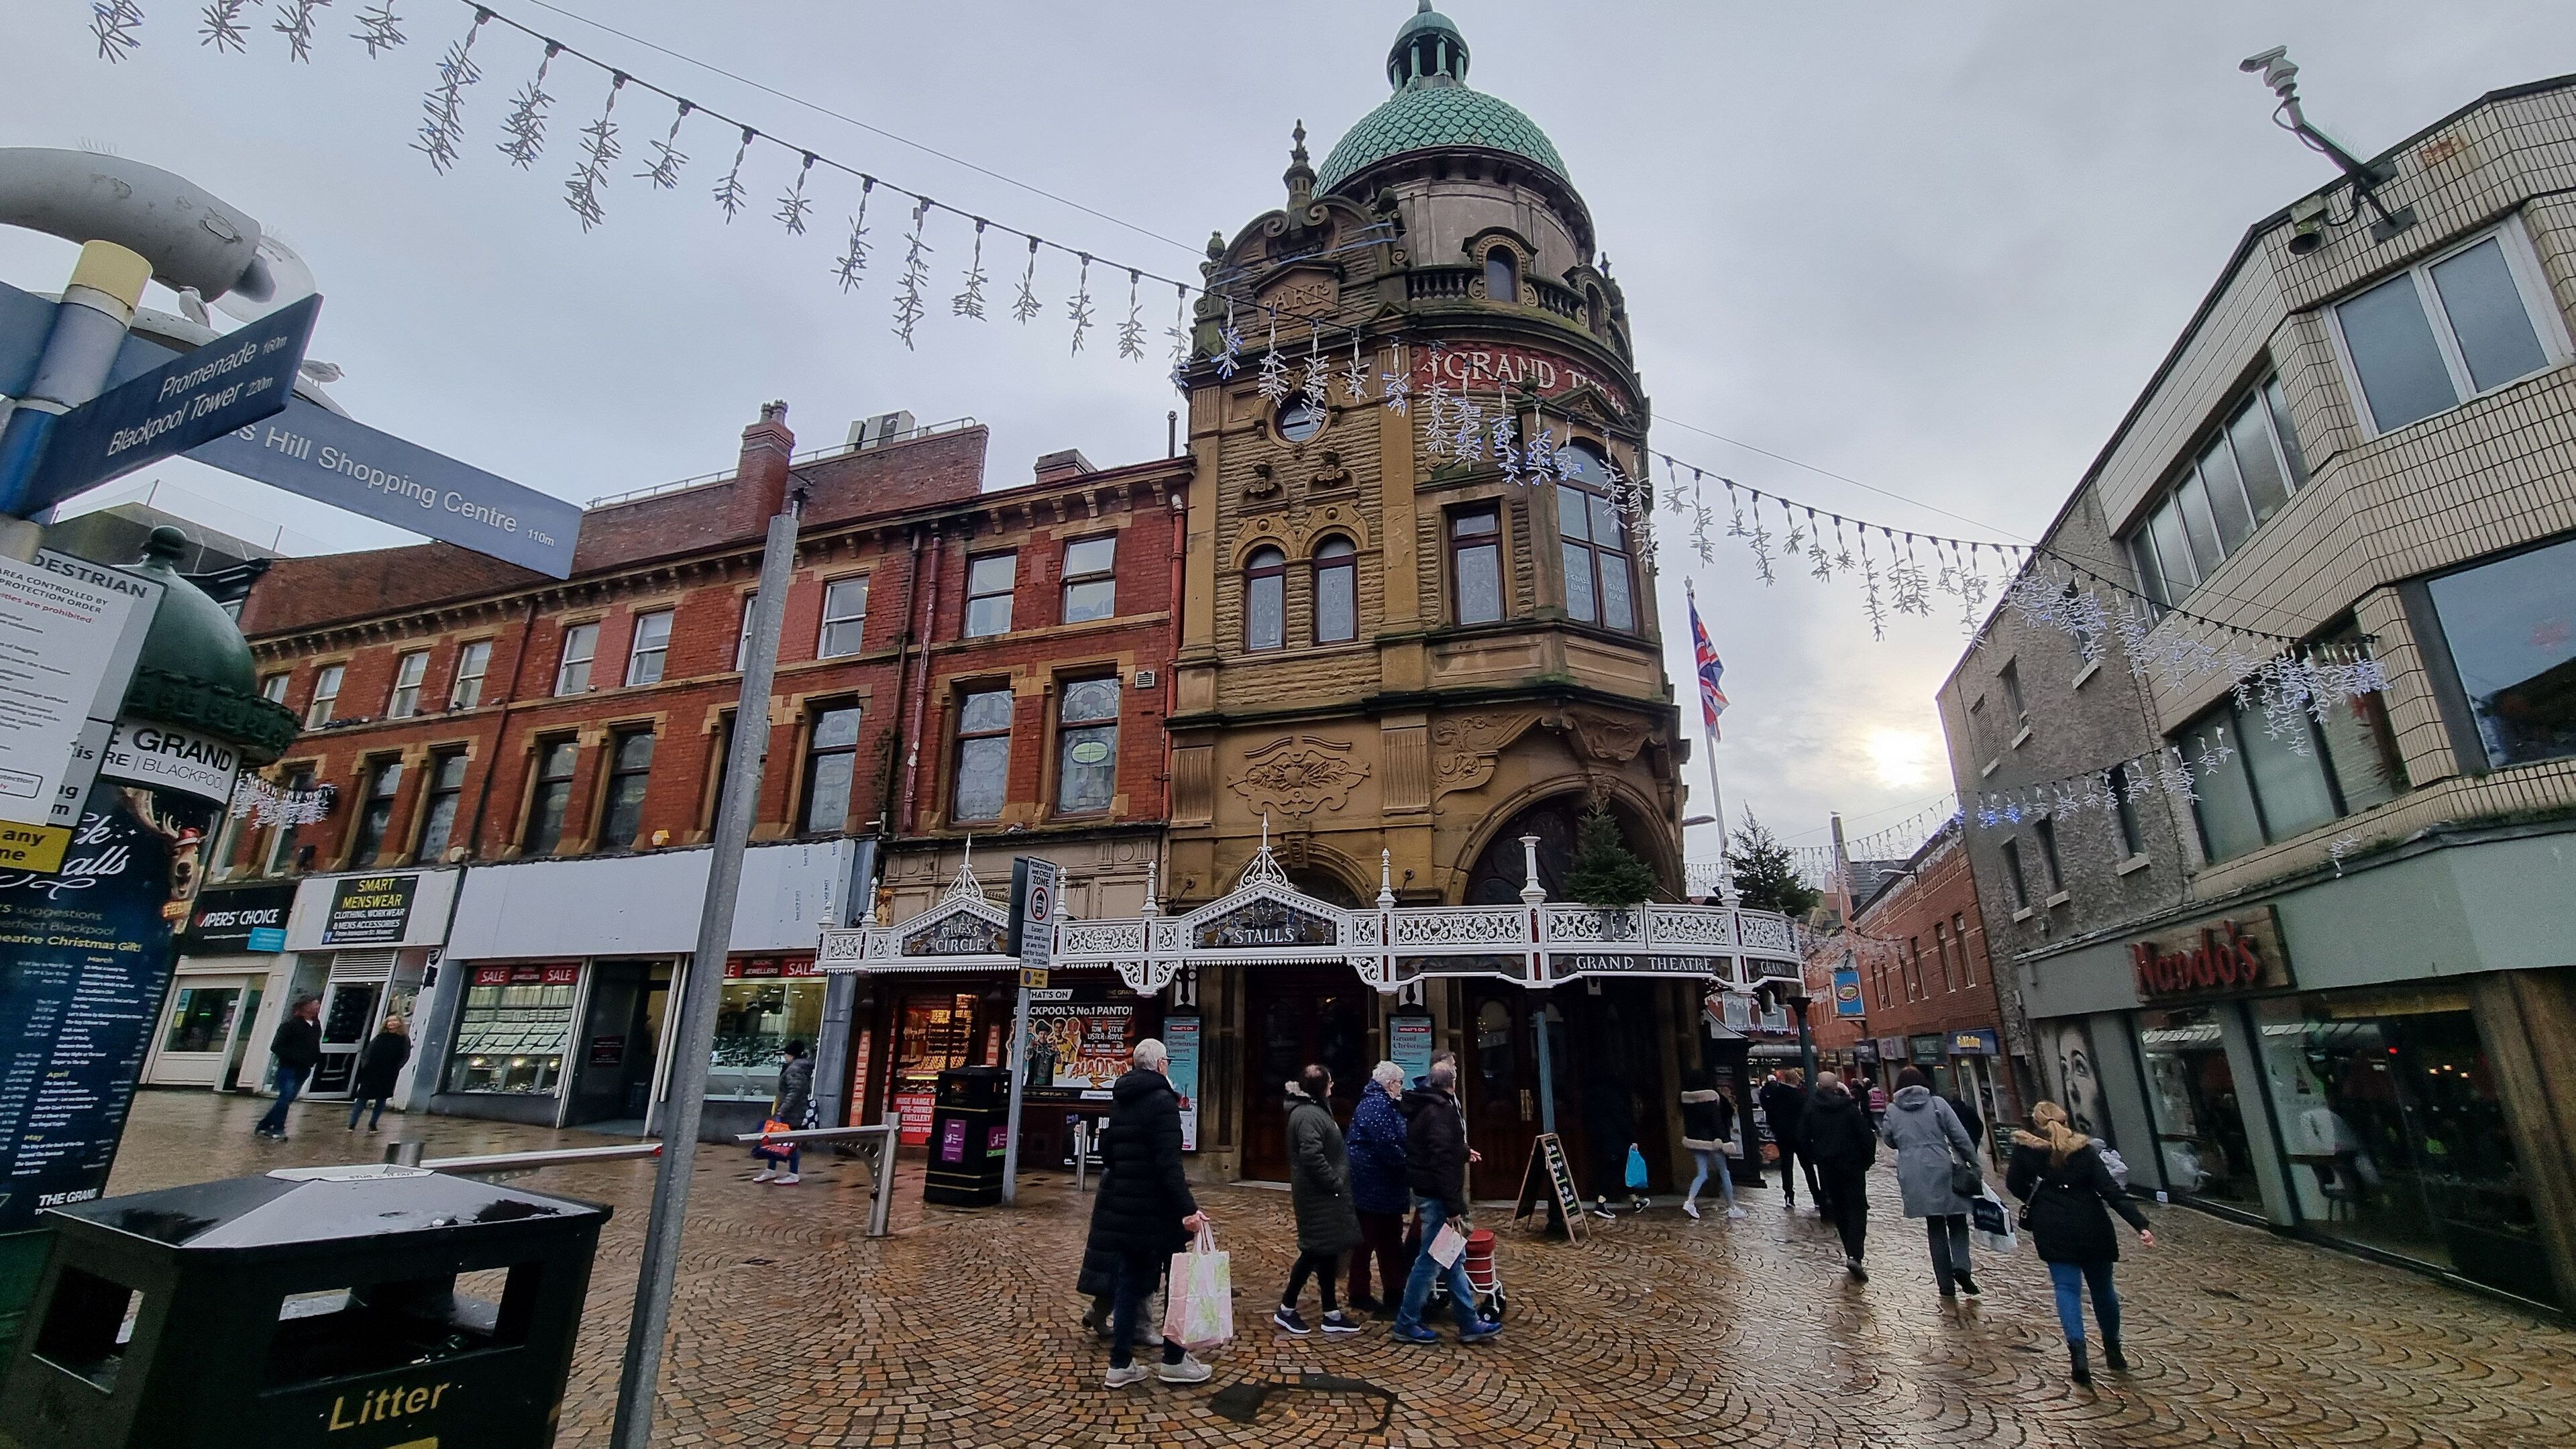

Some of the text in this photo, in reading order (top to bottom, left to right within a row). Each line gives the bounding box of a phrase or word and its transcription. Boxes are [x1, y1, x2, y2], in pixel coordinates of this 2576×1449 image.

[158, 336, 287, 402] Promenade 160m
[1444, 352, 1556, 388] GRAND
[107, 376, 273, 457] Blackpool Tower 220m
[265, 427, 312, 461] Hill
[317, 446, 437, 509] Shopping
[443, 491, 518, 533] Centre
[527, 528, 555, 547] 110m
[27, 577, 93, 602] CONTROLLED
[96, 598, 108, 606] BY
[25, 600, 40, 609] are
[67, 599, 102, 614] ORDER
[133, 729, 233, 772] GRAND
[5, 830, 47, 847] any
[1030, 861, 1054, 872] PEDESTRIAN
[358, 878, 396, 892] SMART
[1033, 875, 1049, 887] ZONE
[342, 894, 402, 909] MENSWEAR
[14, 907, 103, 920] suggestions
[239, 908, 280, 924] CHOICE
[367, 908, 406, 917] WORKWEAR
[50, 922, 116, 936] Blackpool
[356, 919, 401, 929] ACCESSORIES
[941, 923, 981, 938] DRESS
[1234, 927, 1295, 944] STALLS
[47, 936, 116, 951] Christmas
[936, 938, 985, 953] CIRCLE
[87, 956, 114, 964] March
[1576, 955, 1713, 971] GRAND THEATRE
[2131, 918, 2257, 996] Nando's
[1760, 960, 1786, 975] GRAND
[481, 971, 506, 982] SALE
[547, 969, 572, 981] SALE
[1055, 991, 1068, 999] ON
[1077, 1006, 1095, 1015] No.1
[1097, 1006, 1132, 1016] PANTO!
[1087, 1032, 1124, 1040] LISTER ROYLE
[46, 1070, 70, 1079] April
[1068, 1057, 1128, 1079] ALADDIN
[912, 1097, 930, 1106] RANGE
[900, 1106, 932, 1114] PRE-OWNED
[39, 1188, 98, 1207] THE GRAND
[328, 1382, 450, 1431] Litter
